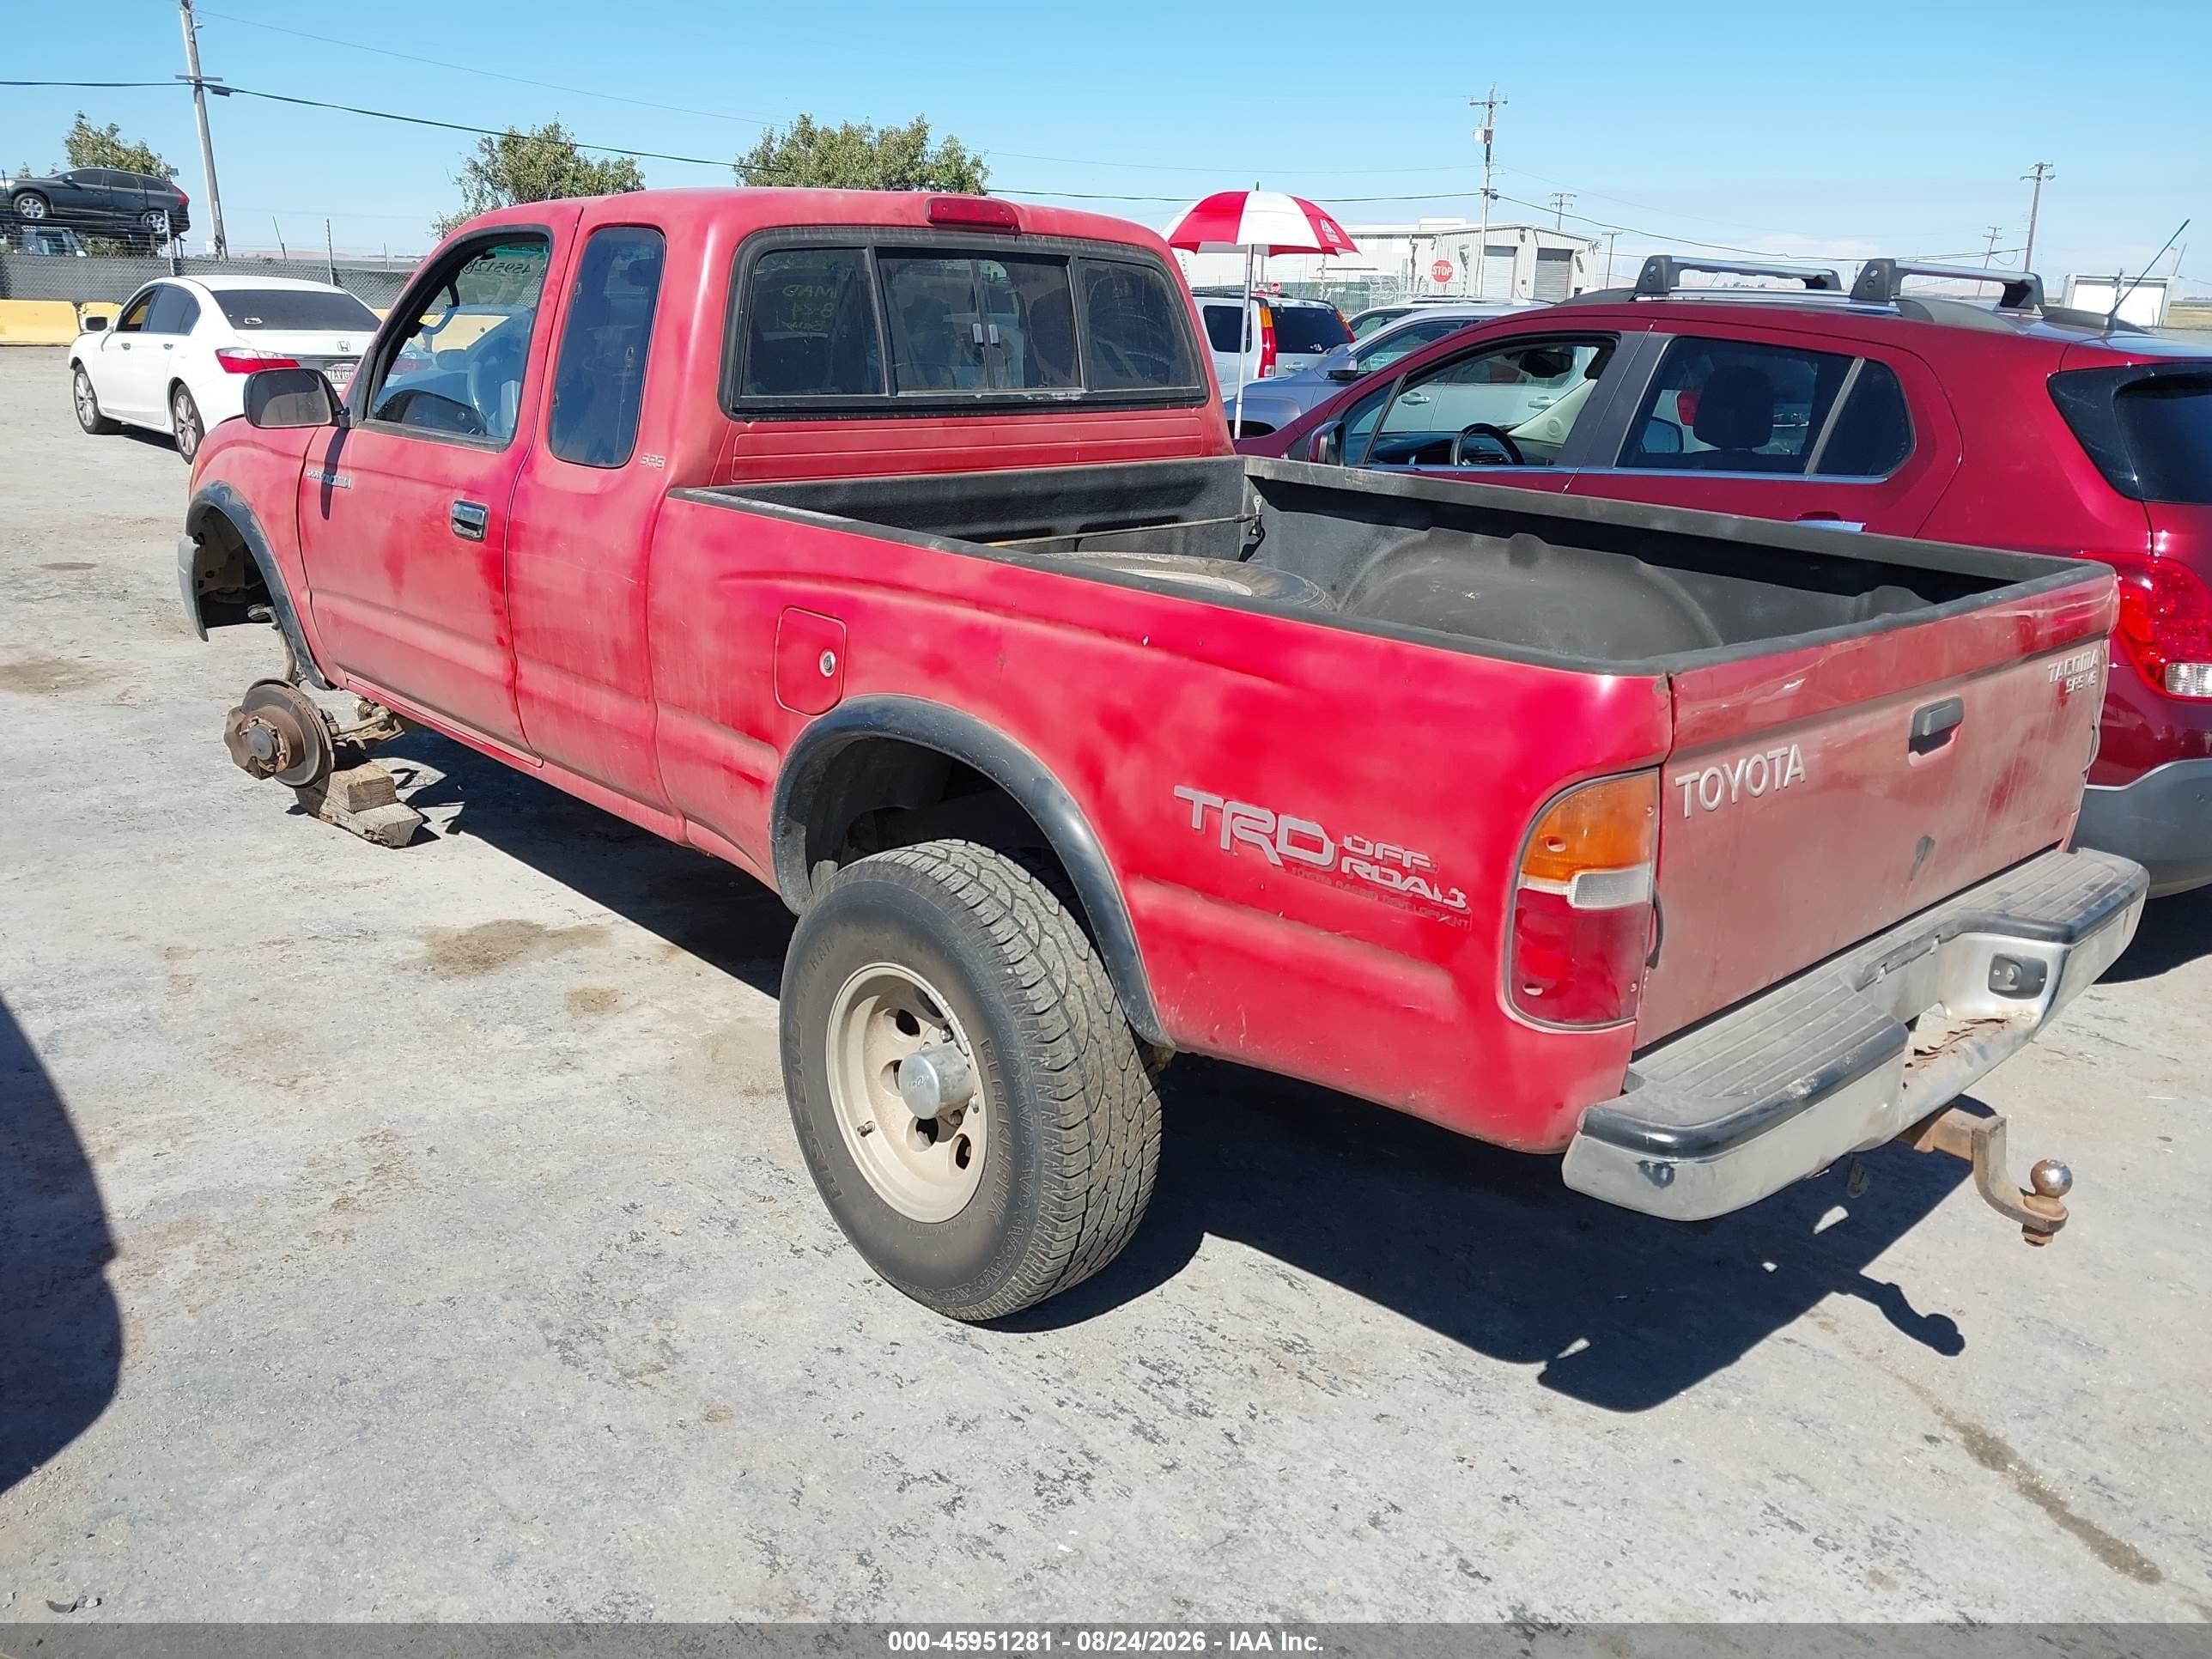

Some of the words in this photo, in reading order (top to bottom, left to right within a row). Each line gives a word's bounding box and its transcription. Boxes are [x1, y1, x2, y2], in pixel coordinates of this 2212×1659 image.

[1431, 265, 1453, 276] STOP
[2047, 648, 2099, 684] TACOMA
[1675, 744, 1806, 818] TOYOTA
[1174, 785, 1338, 870] TRD
[1342, 835, 1436, 869] OFF
